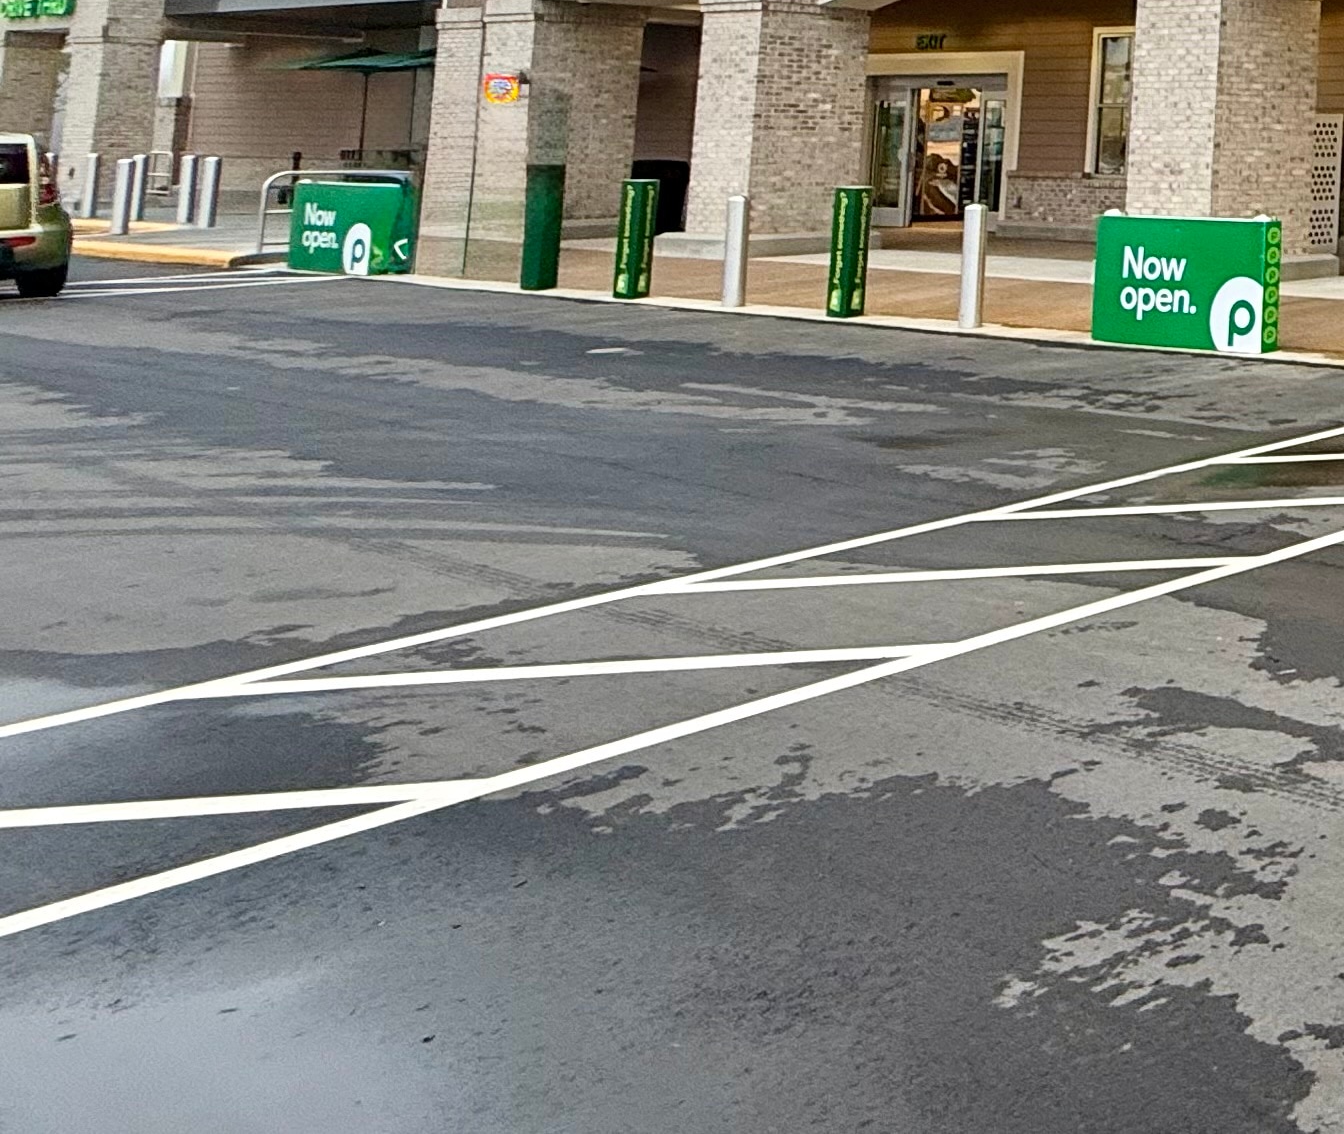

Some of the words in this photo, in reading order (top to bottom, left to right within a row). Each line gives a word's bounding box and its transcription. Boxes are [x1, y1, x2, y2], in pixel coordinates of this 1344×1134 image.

[304, 202, 337, 226] Now
[302, 230, 339, 254] open.
[1122, 245, 1187, 282] Now
[1120, 286, 1197, 321] open.
